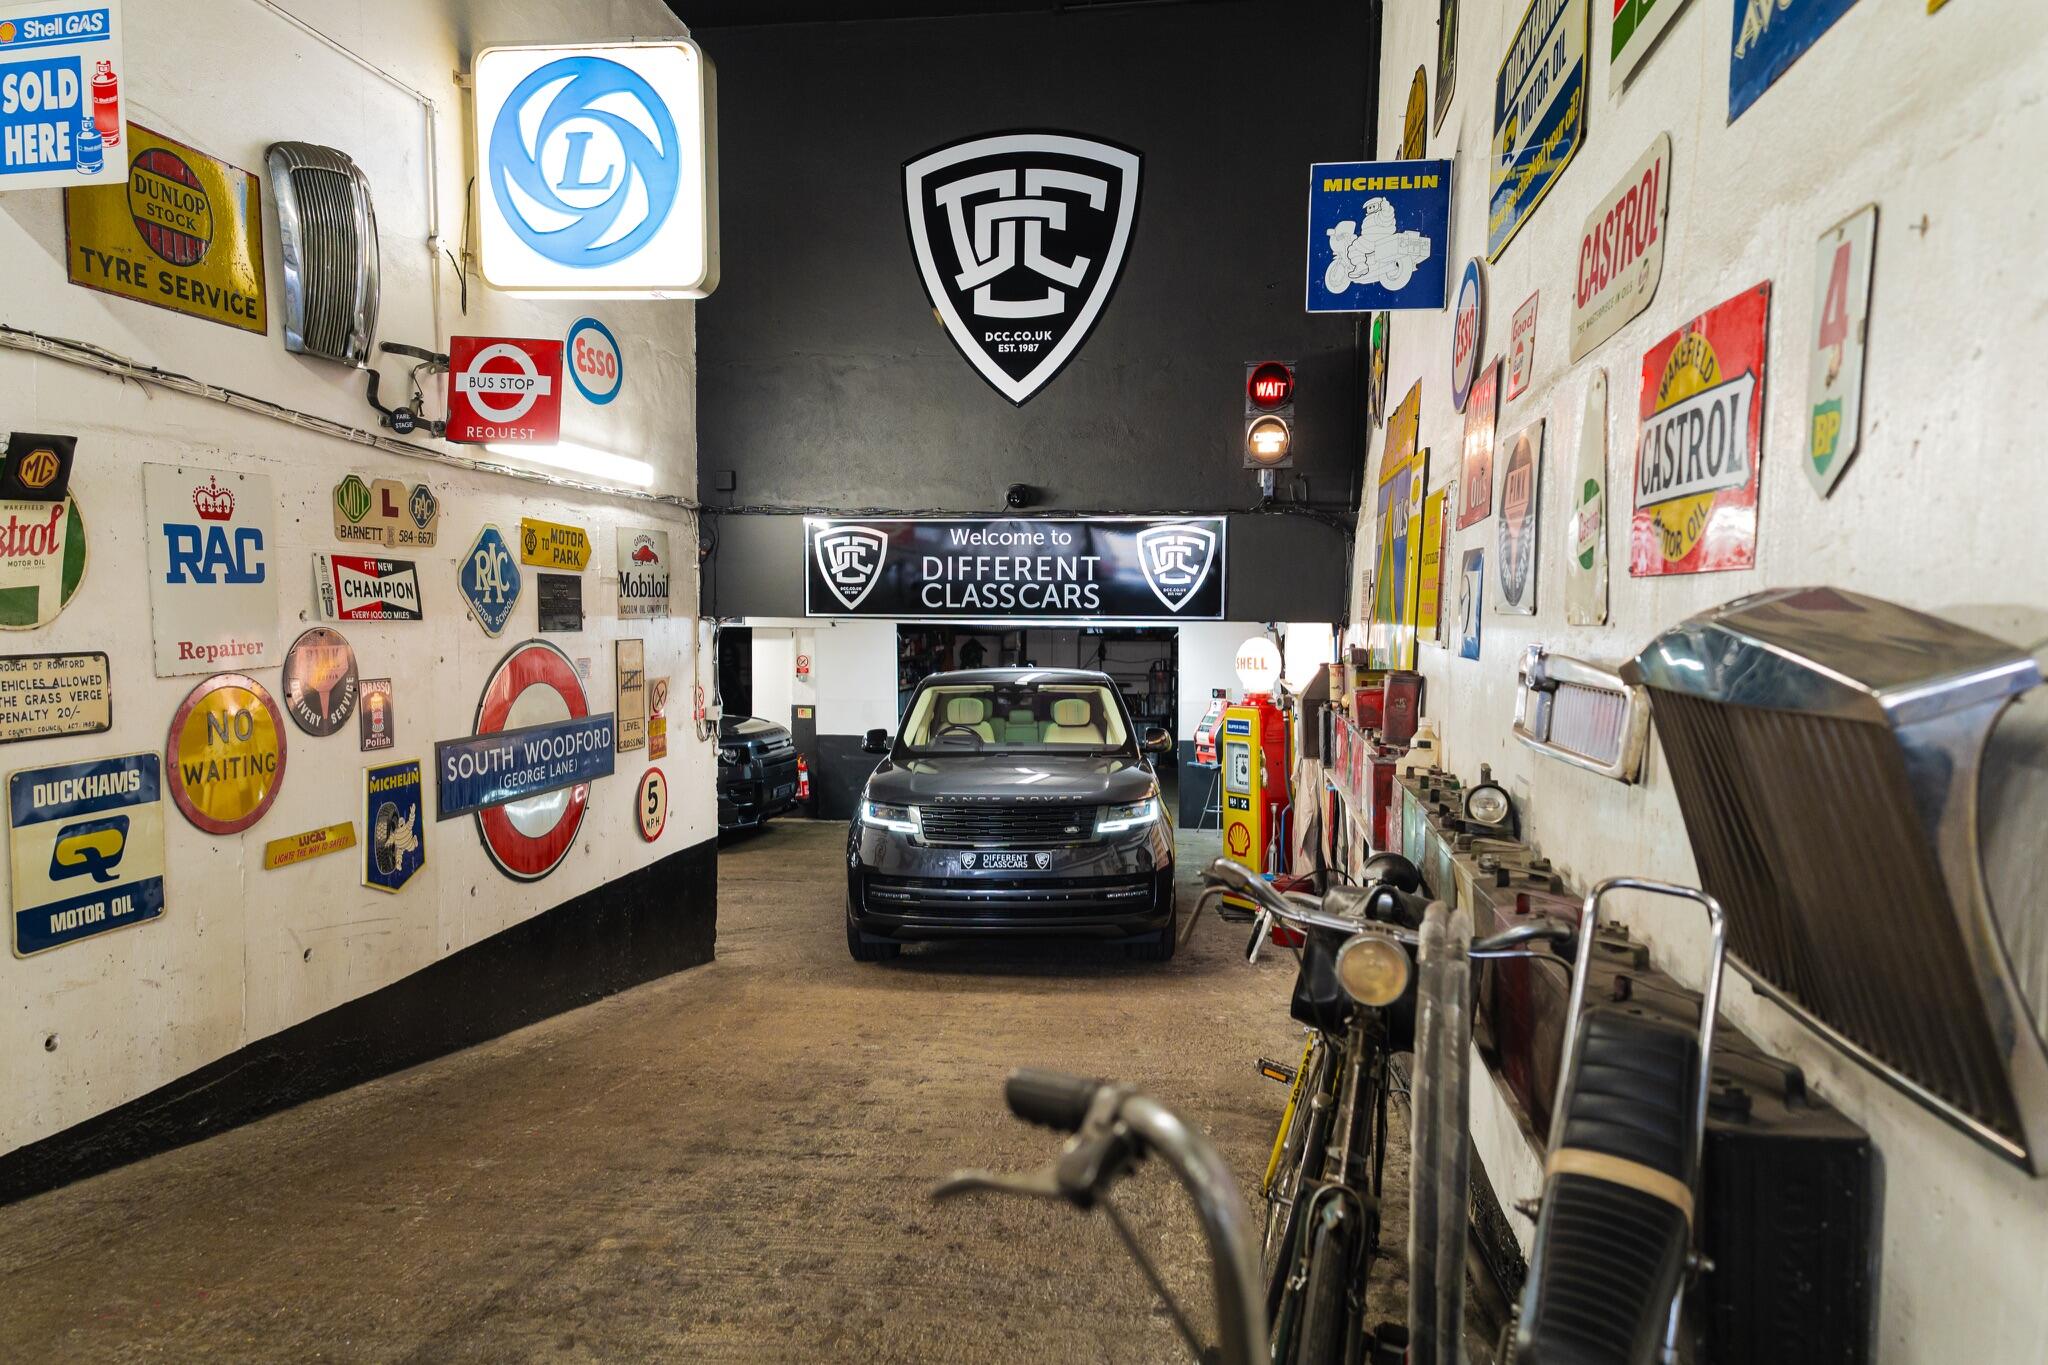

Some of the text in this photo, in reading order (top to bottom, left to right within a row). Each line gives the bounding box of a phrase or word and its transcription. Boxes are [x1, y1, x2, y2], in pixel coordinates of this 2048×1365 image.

[24, 13, 104, 39] Shell GAS
[1504, 0, 1564, 113] DUCKHA
[2, 68, 79, 115] SOLD
[1521, 28, 1567, 136] MOTOR OIL
[4, 121, 71, 166] HERE
[556, 131, 614, 190] L
[134, 174, 206, 216] DUNLOP
[1323, 175, 1439, 193] MICHELIN
[146, 202, 198, 232] STOCK
[1577, 157, 1660, 309] CASTROL
[79, 246, 258, 321] TYRE SERVICE
[1819, 241, 1852, 351] 4
[985, 330, 1053, 342] DCC.CO.UK
[998, 343, 1040, 353] EST. 1987
[1659, 337, 1715, 403] WAKEFIELD
[469, 377, 535, 391] BUS STOP
[1256, 381, 1287, 397] WAIT
[395, 420, 414, 430] STAGE
[466, 425, 536, 441] REQUEST
[1812, 411, 1840, 458] BP
[1641, 392, 1743, 496] CASTROL
[24, 457, 56, 484] MG
[382, 488, 399, 518] L
[1393, 498, 1409, 540] OILS
[1687, 502, 1708, 543] OIL
[340, 524, 383, 541] BARNETT
[399, 529, 434, 545] 584-6671
[541, 538, 550, 551] TO
[550, 528, 584, 549] MOTOR
[950, 528, 1072, 546] Welcome to
[8, 560, 32, 568] MOTOR
[163, 523, 265, 584] RAC
[364, 560, 393, 572] FIT NEW
[475, 543, 510, 603] RAC
[923, 556, 1101, 581] DIFFERENT
[344, 579, 414, 600] CHAMPION
[618, 570, 669, 598] Mobiloil
[921, 582, 1100, 609] CLASSCARS
[351, 610, 370, 619] EVERY
[393, 611, 410, 619] MILES
[473, 598, 515, 625] MOTOR SCHOOL
[178, 639, 264, 664] Repairer
[1236, 656, 1269, 671] SHELL
[33, 661, 43, 671] OF
[47, 659, 85, 670] ROMFORD
[1, 674, 102, 692] EHICLES ALLOWED
[361, 681, 391, 698] BRASSO
[25, 692, 62, 706] GRASS
[70, 689, 102, 702] VERGE
[290, 676, 354, 728] DELIVERY SERVICE
[0, 709, 49, 725] PENALTY
[206, 708, 254, 747] NO
[623, 722, 641, 732] LEVEL
[8, 727, 32, 737] COUNTY
[365, 736, 391, 748] Polish
[619, 736, 645, 750] CROSSING
[447, 745, 514, 782] SOUTH
[524, 726, 611, 765] WOODFORD
[183, 752, 278, 786] WAITING
[499, 757, 578, 792] (GEORGE LANE)
[33, 768, 141, 809] DUCKHAMS
[369, 771, 419, 795] MICHELIN
[647, 780, 659, 815] 5
[934, 795, 1001, 803] RANGE
[298, 830, 327, 847] LUCAS
[273, 851, 295, 865] LIGHTS
[982, 853, 1029, 862] DIFFERENT
[982, 860, 1029, 869] CLASSCARS
[50, 894, 135, 934] MOTOR OIL
